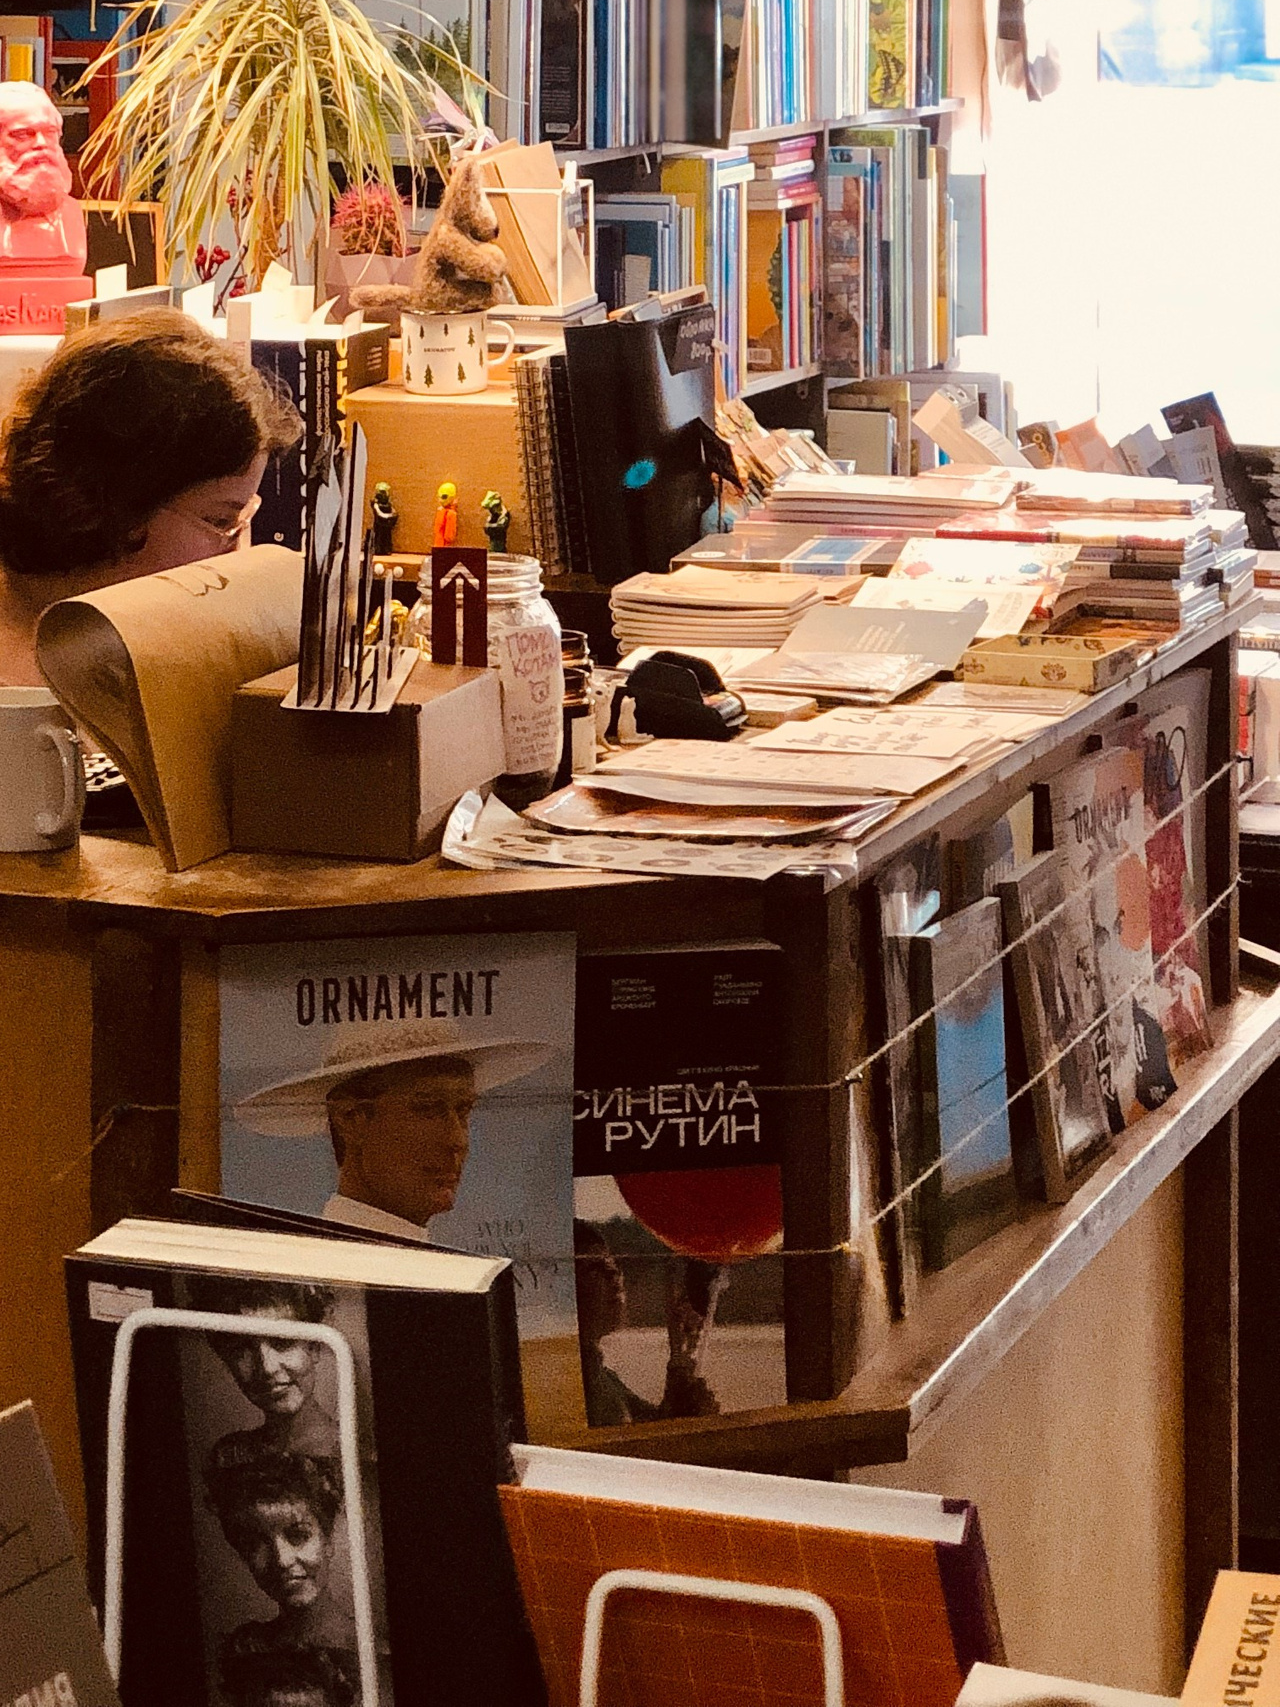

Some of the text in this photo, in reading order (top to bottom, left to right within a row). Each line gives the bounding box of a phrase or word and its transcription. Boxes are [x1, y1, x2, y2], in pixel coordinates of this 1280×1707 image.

[295, 969, 501, 1027] ORNAMENT
[572, 1080, 760, 1122] СИНЕМА
[604, 1113, 761, 1154] РУТИН
